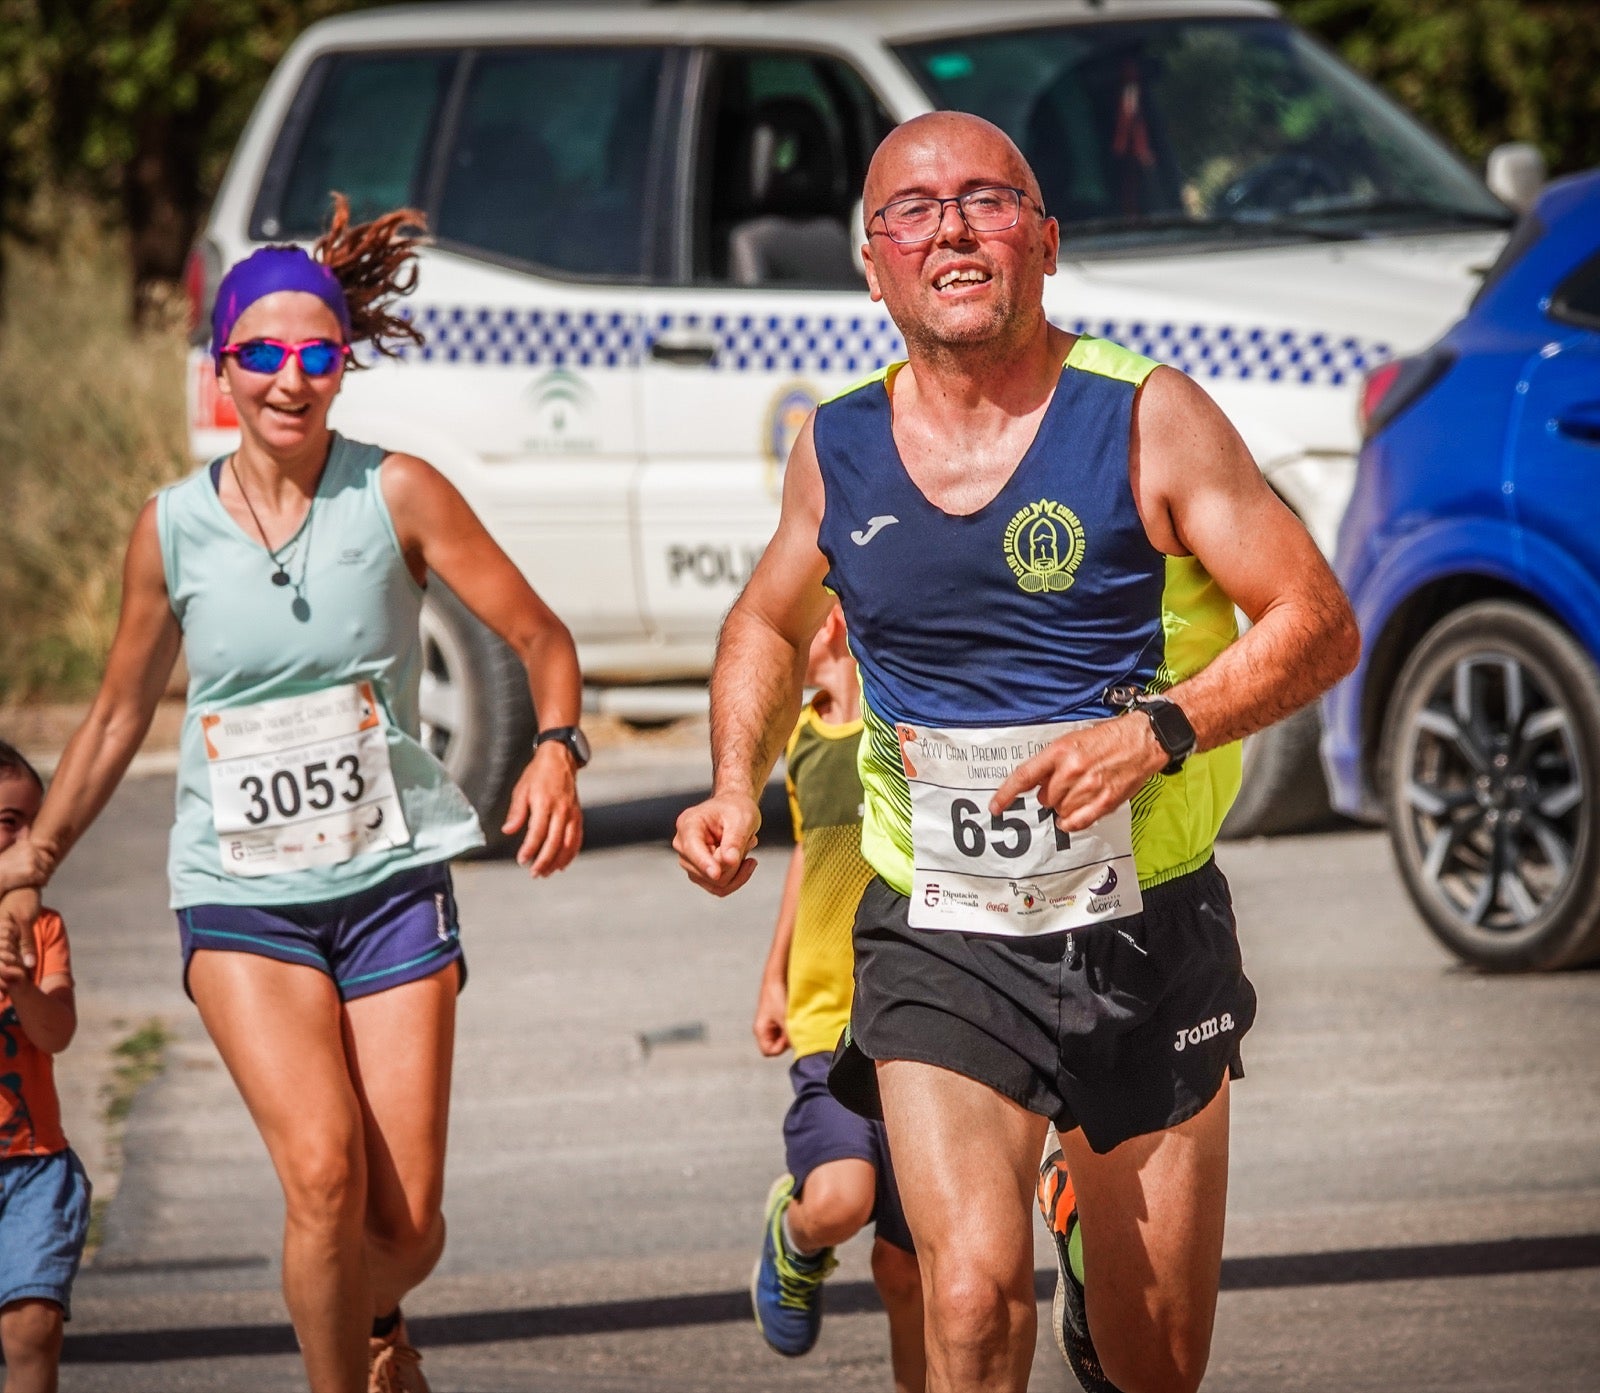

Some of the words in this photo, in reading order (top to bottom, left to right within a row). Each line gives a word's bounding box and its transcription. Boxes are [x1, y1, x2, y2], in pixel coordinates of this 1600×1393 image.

[1003, 506, 1031, 553] ATLETISMO
[664, 544, 762, 588] POLI
[1006, 554, 1025, 577] CLUB
[1064, 540, 1086, 574] GRANADA
[971, 744, 1008, 762] PREMIO
[1011, 745, 1024, 760] DE
[1027, 740, 1053, 758] FON
[967, 765, 1009, 779] UNIVERSO
[239, 754, 365, 825] 3053
[950, 796, 1072, 859] 651
[942, 889, 979, 900] Diputación
[1089, 895, 1122, 913] Lorca
[1173, 1012, 1235, 1052] Joma
